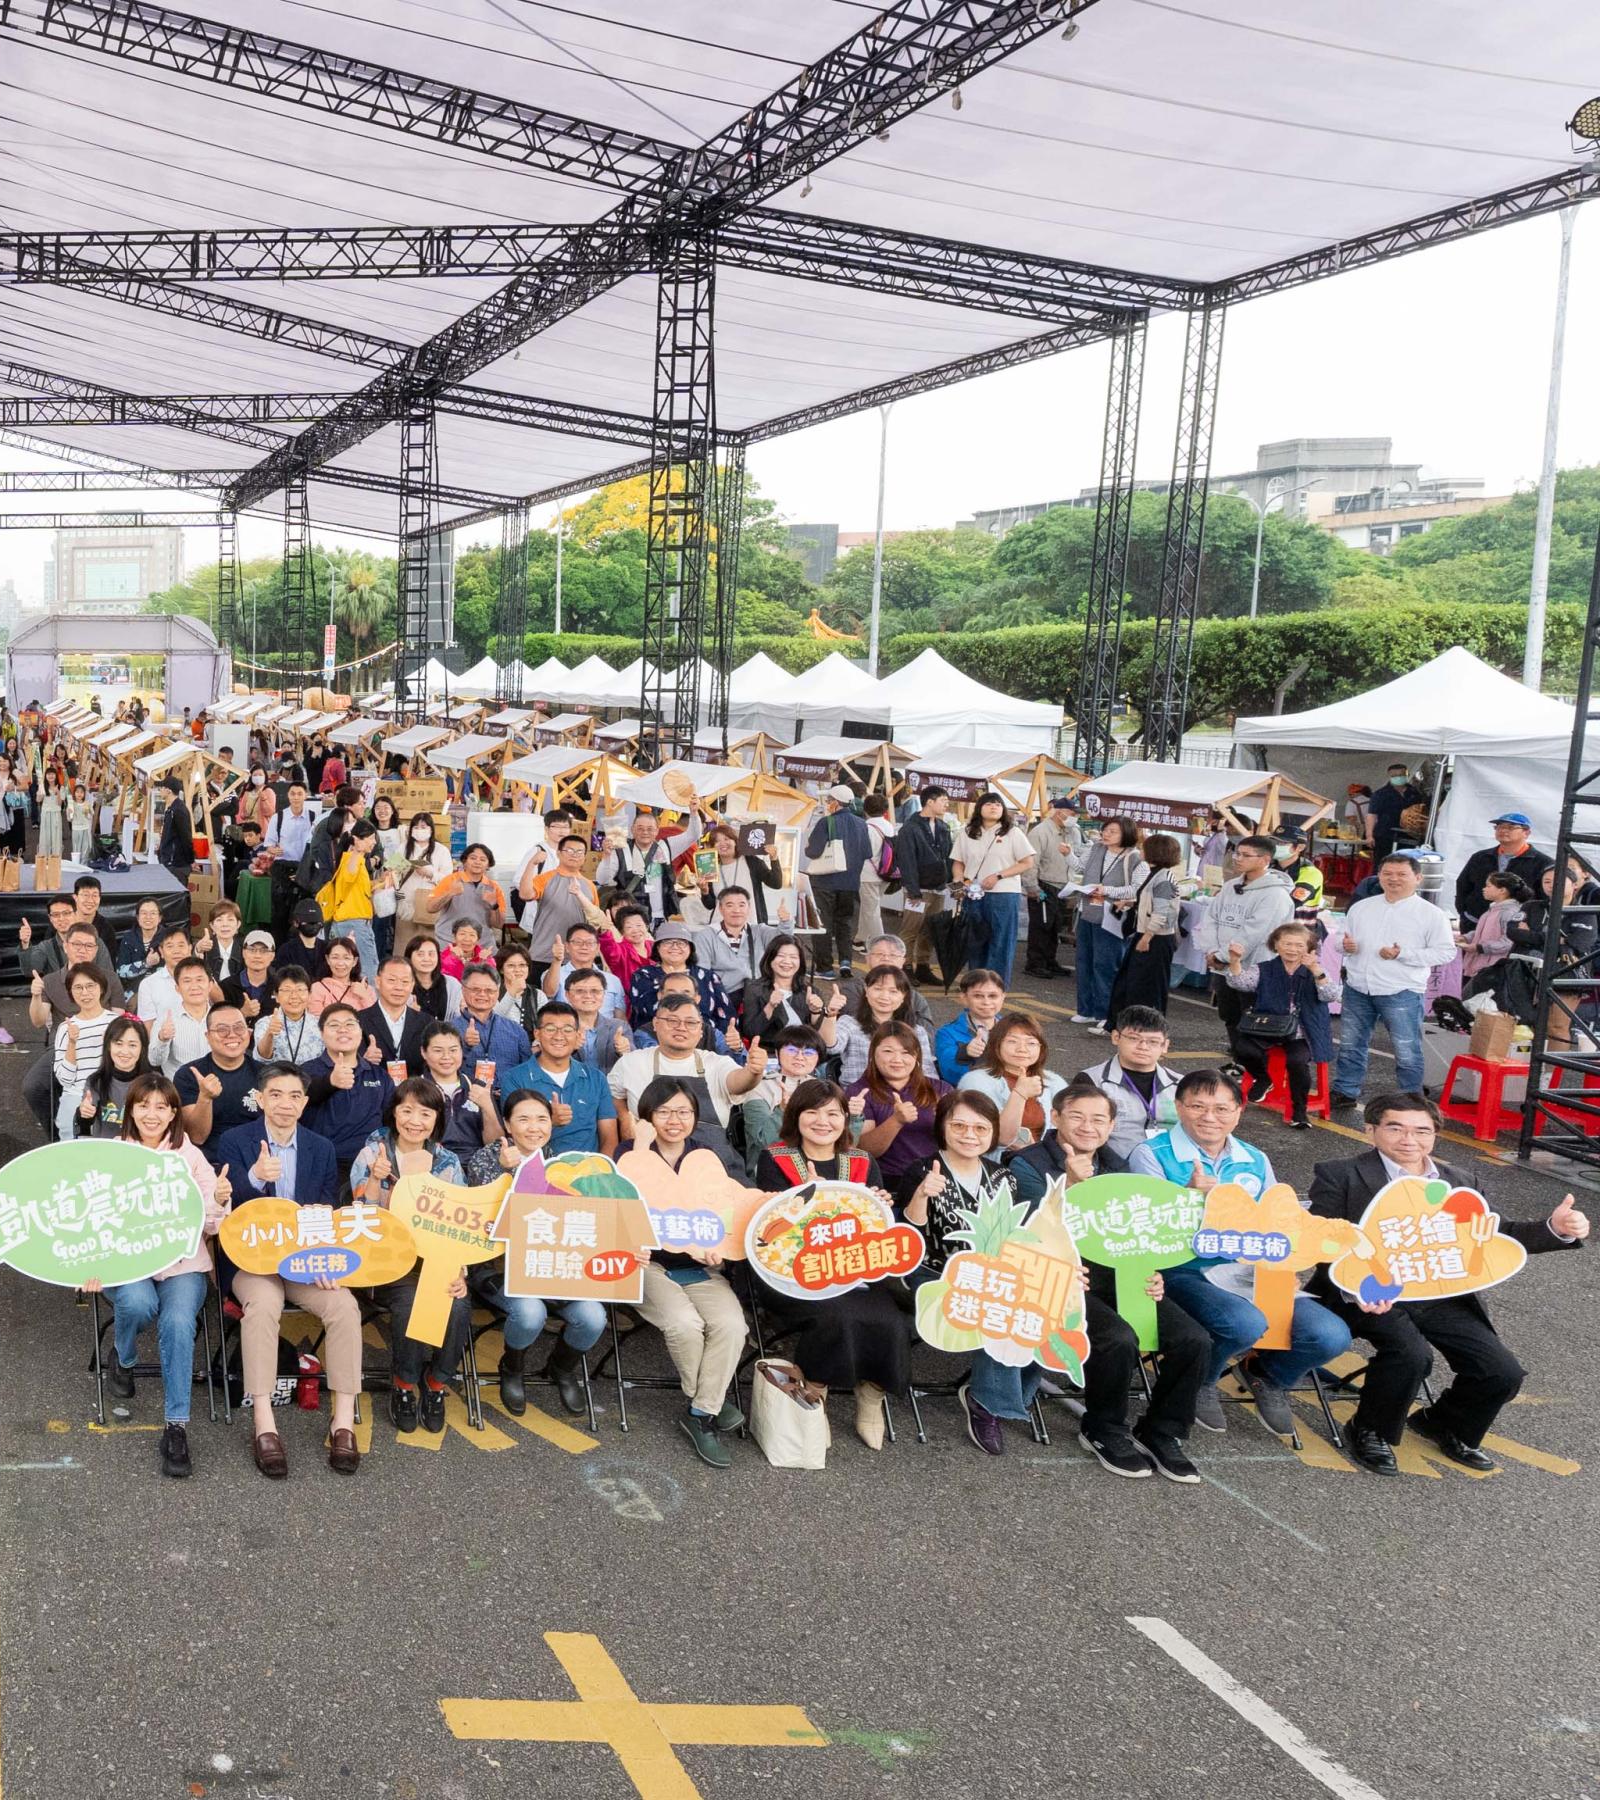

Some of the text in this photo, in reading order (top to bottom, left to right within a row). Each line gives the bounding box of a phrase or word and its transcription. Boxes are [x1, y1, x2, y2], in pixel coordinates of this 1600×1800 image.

[1087, 801, 1099, 814] 46
[420, 1184, 446, 1199] 2026
[241, 1201, 384, 1248] 小小農夫
[415, 1194, 483, 1231] 04.03
[522, 1207, 598, 1247] 食農
[1378, 1210, 1458, 1249] 彩繪
[808, 1218, 857, 1247] 來呷
[1196, 1233, 1288, 1257] 稻草藝術
[288, 1253, 349, 1274] 出任務
[524, 1249, 629, 1279] 體驗 DIY
[800, 1235, 911, 1283] 割稻飯!
[1387, 1246, 1469, 1285] 街道
[952, 1261, 1017, 1302] 農玩
[948, 1292, 1045, 1342] 迷宮趣
